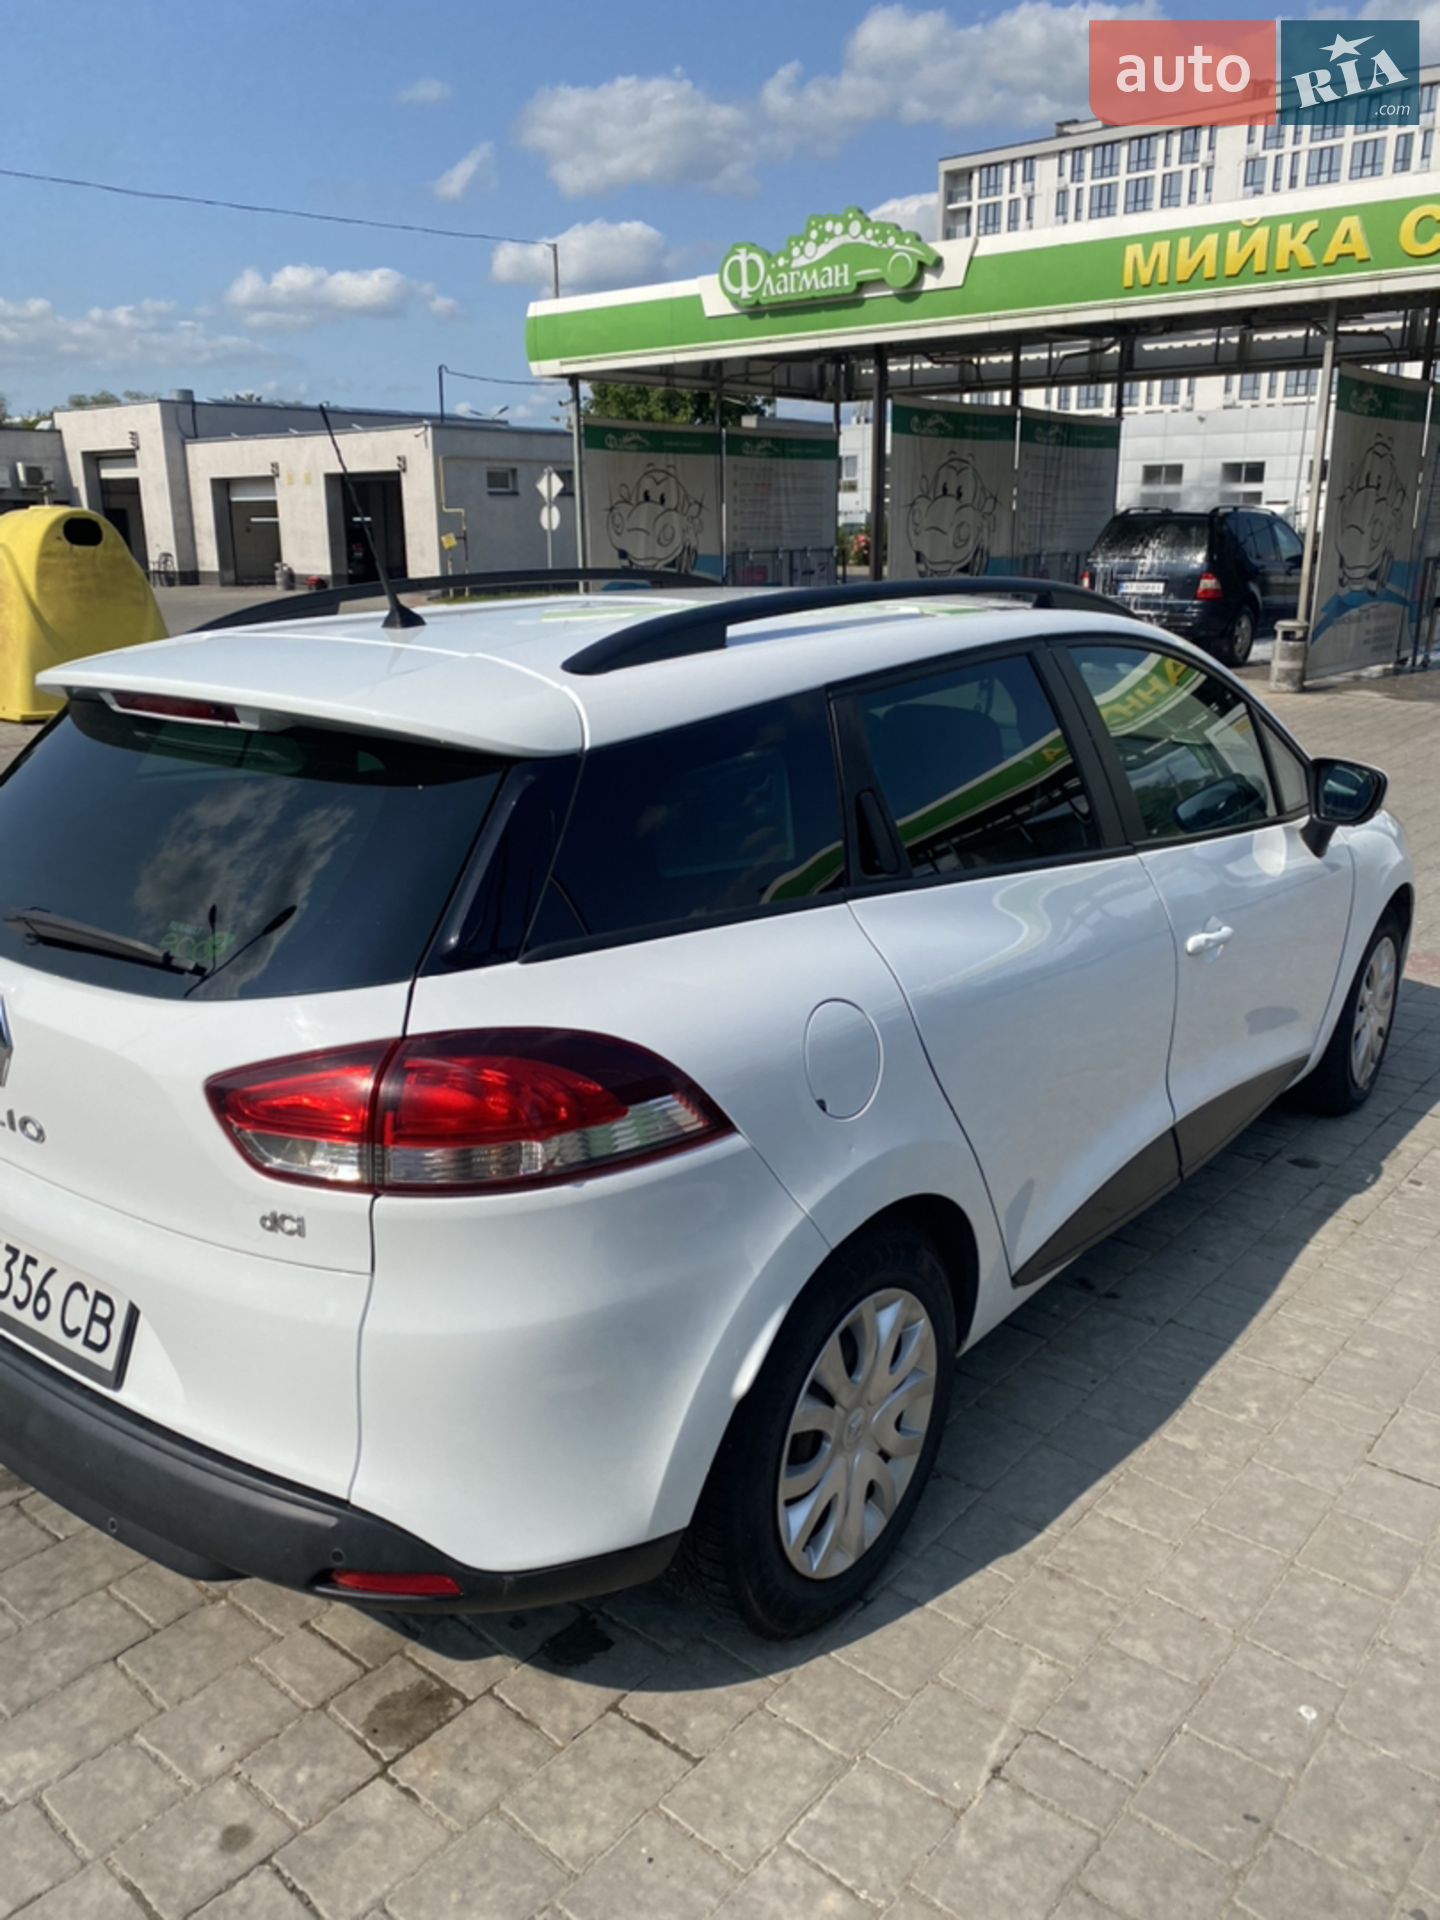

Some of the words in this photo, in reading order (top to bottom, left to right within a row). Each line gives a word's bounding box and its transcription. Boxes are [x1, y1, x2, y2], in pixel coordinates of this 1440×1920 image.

[722, 248, 851, 300] Флагман
[1122, 214, 1372, 289] МИЙКА
[259, 1209, 306, 1239] dCi
[0, 1243, 57, 1321] 356
